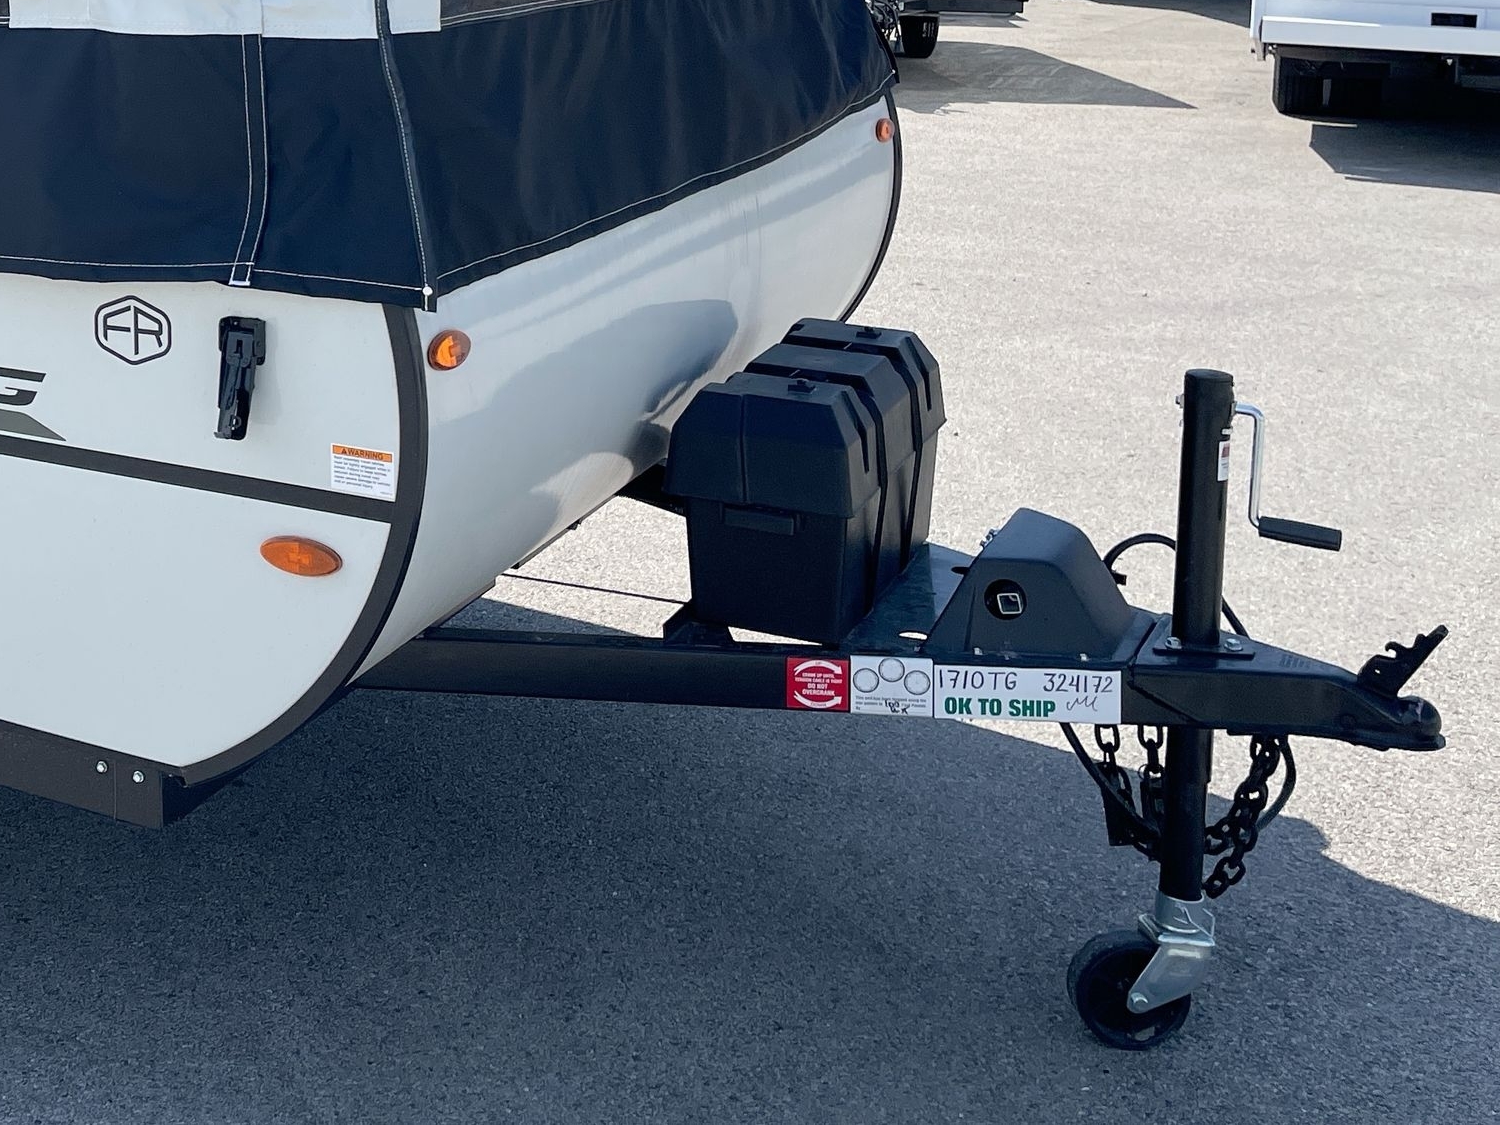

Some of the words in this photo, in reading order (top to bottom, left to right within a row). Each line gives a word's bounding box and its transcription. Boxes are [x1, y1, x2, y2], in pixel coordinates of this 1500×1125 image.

[102, 304, 164, 356] FR
[348, 447, 384, 461] WARNING
[1042, 672, 1114, 694] 324172
[944, 696, 973, 715] OK
[977, 697, 1003, 716] TO
[1008, 698, 1057, 718] SHIP
